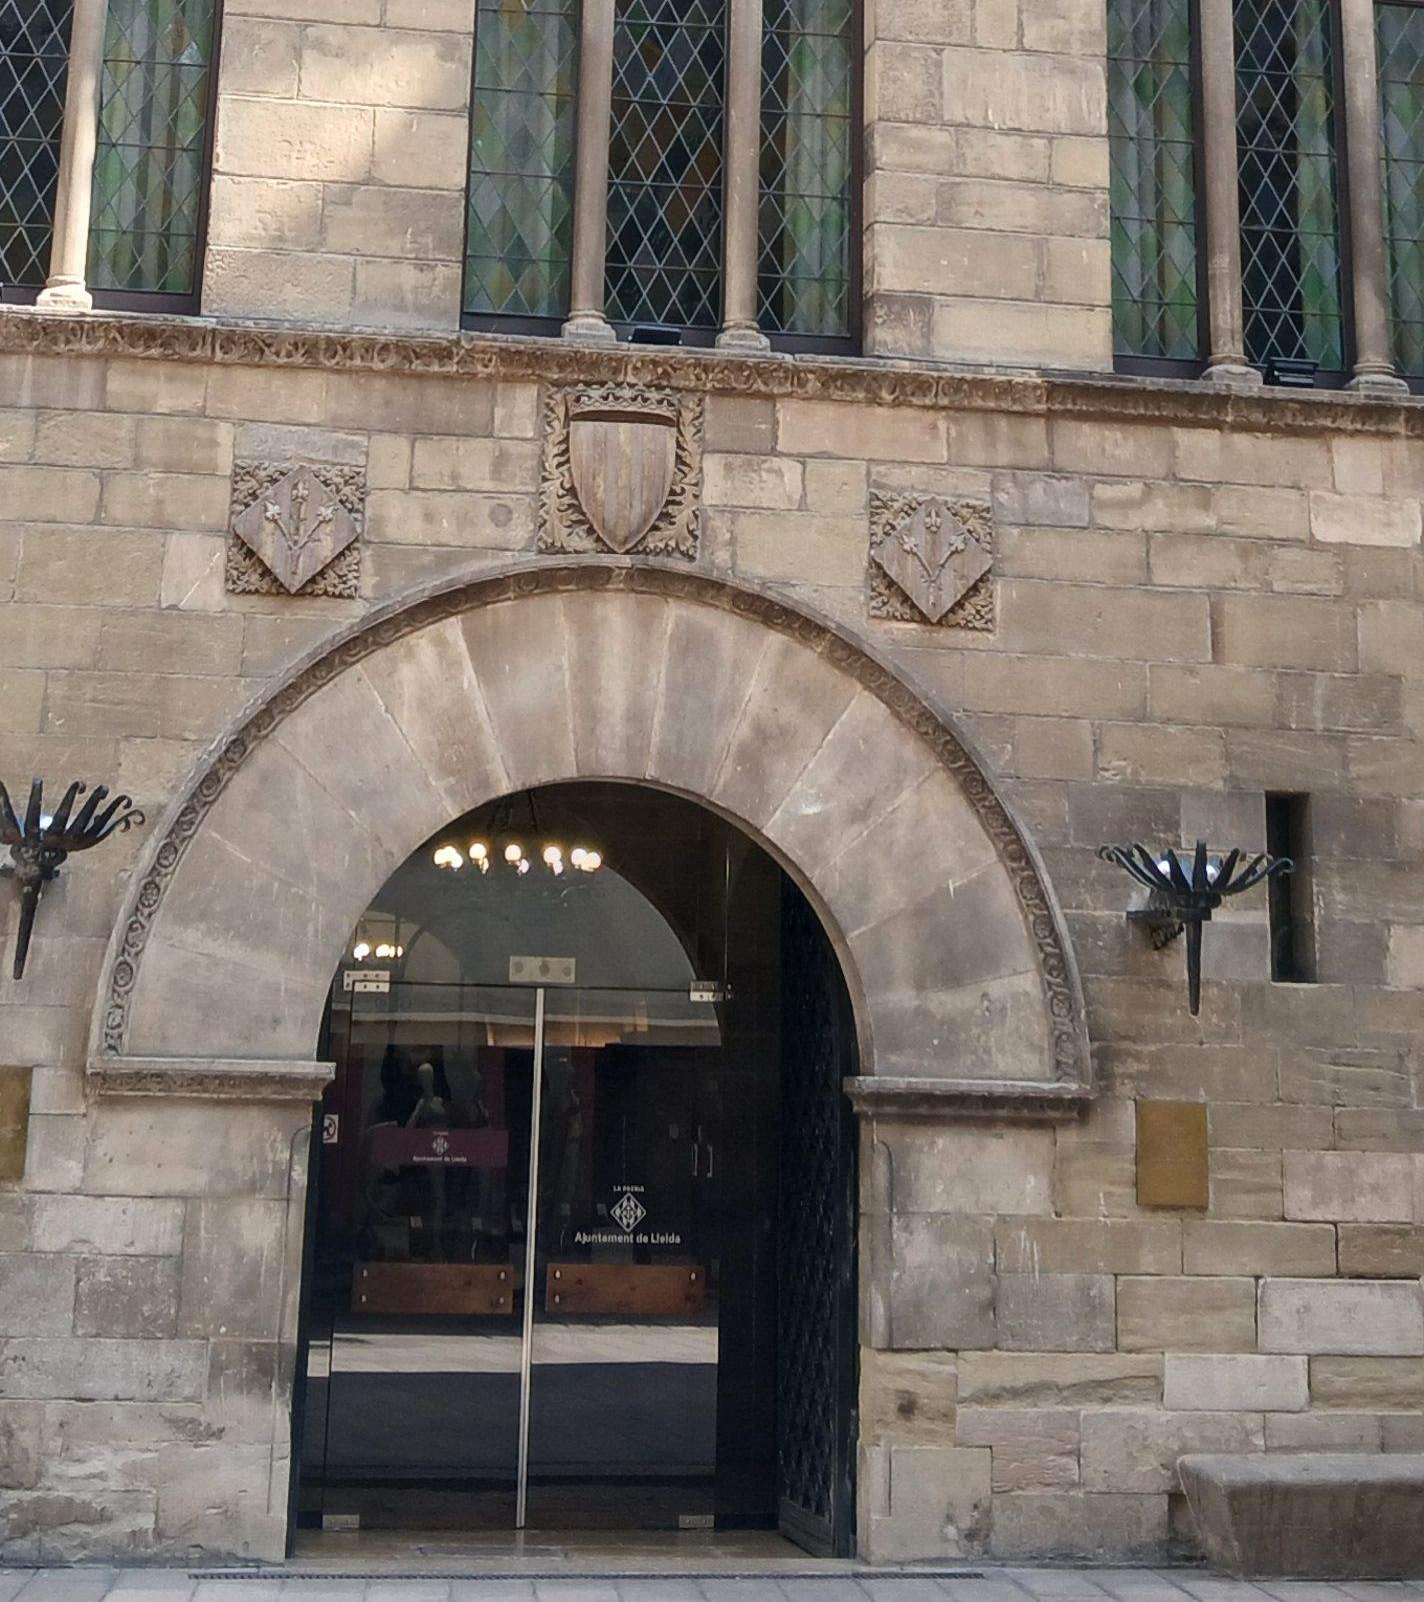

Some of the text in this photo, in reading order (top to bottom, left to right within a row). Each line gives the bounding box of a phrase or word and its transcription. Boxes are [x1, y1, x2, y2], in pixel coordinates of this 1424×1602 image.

[575, 1231, 681, 1245] Ajuntament de Lleida
